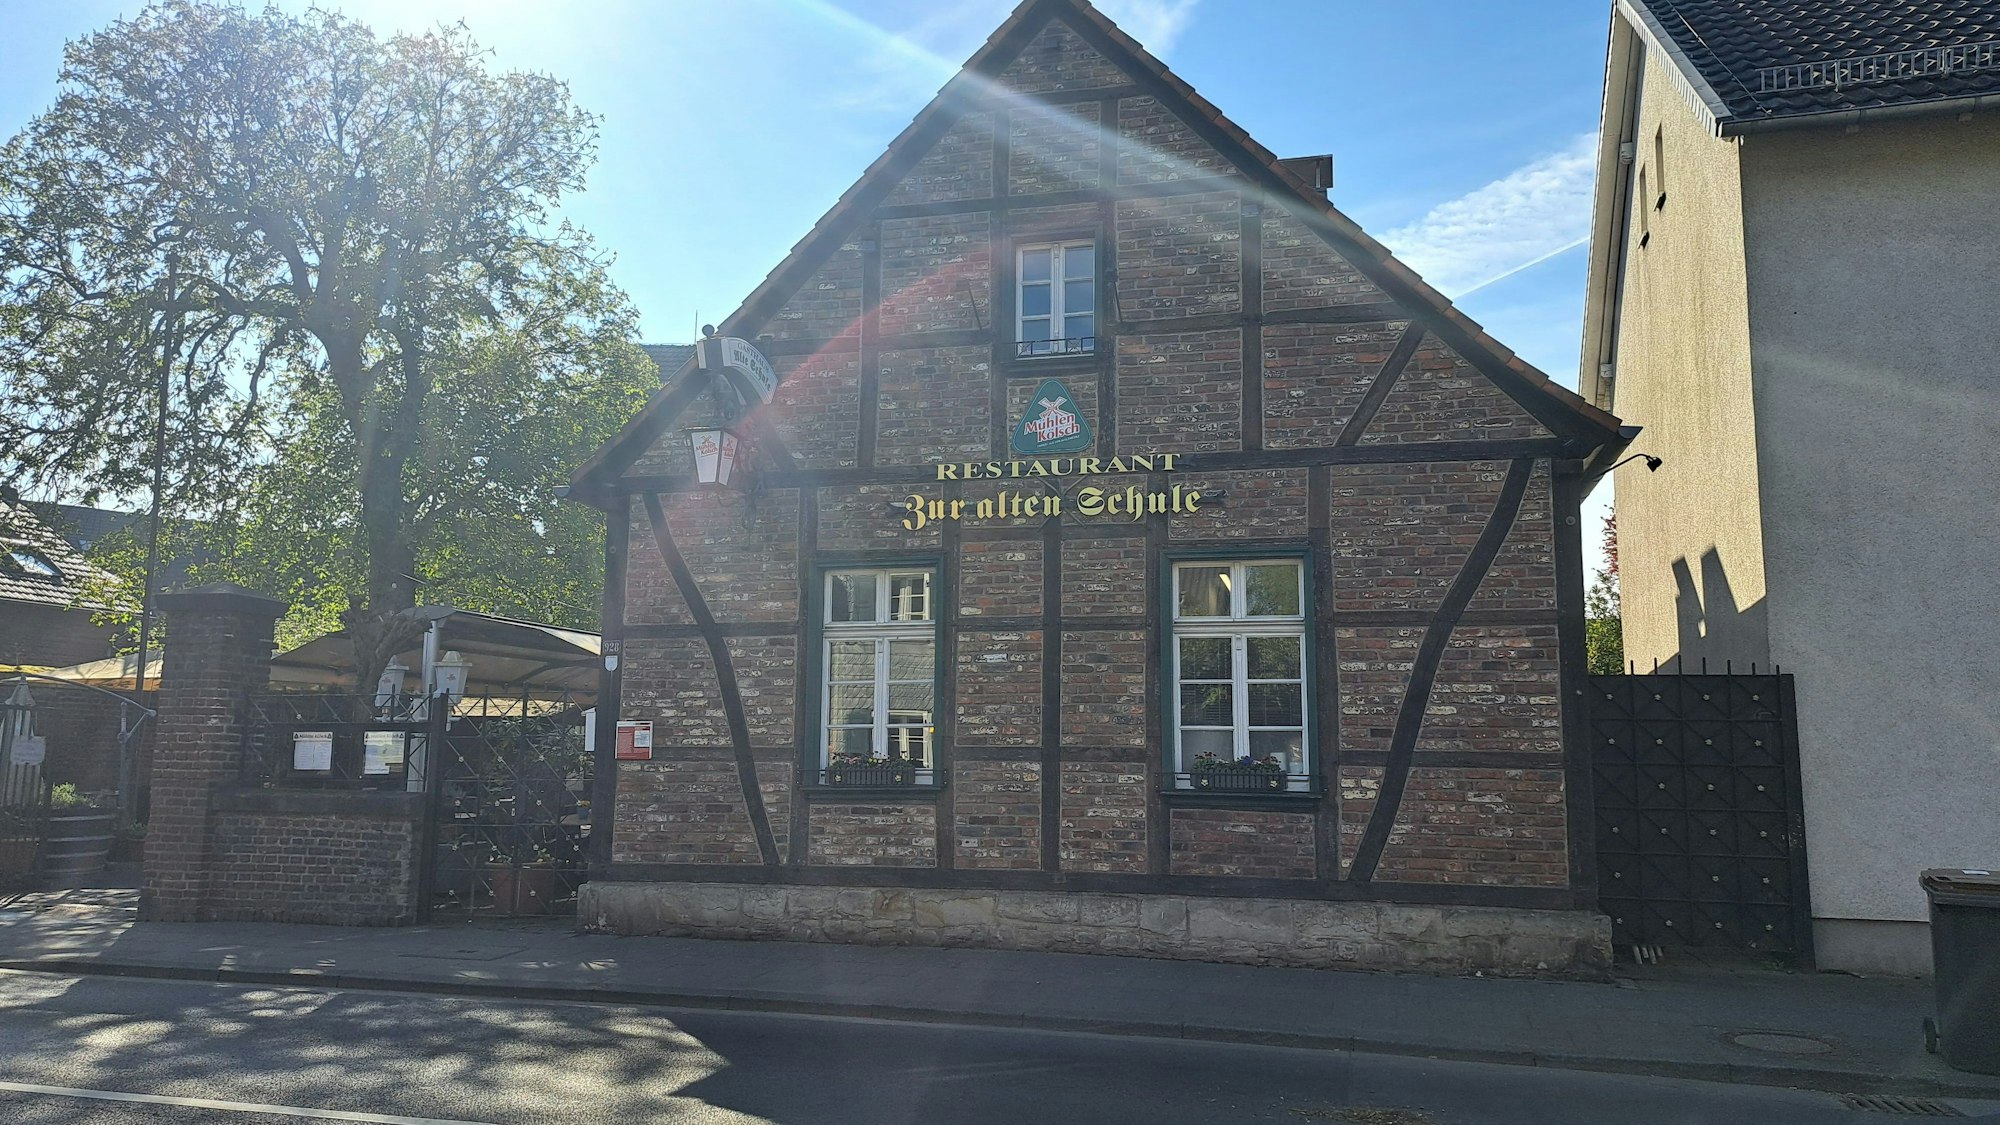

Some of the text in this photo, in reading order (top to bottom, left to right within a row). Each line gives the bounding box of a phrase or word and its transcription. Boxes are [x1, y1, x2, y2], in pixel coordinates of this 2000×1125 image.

[733, 349, 771, 392] Alte Schule
[1025, 413, 1074, 433] Mühlen
[1038, 422, 1079, 442] Kölsch
[937, 453, 1181, 480] RESTAURANT
[902, 484, 1202, 531] Zur alten Schule
